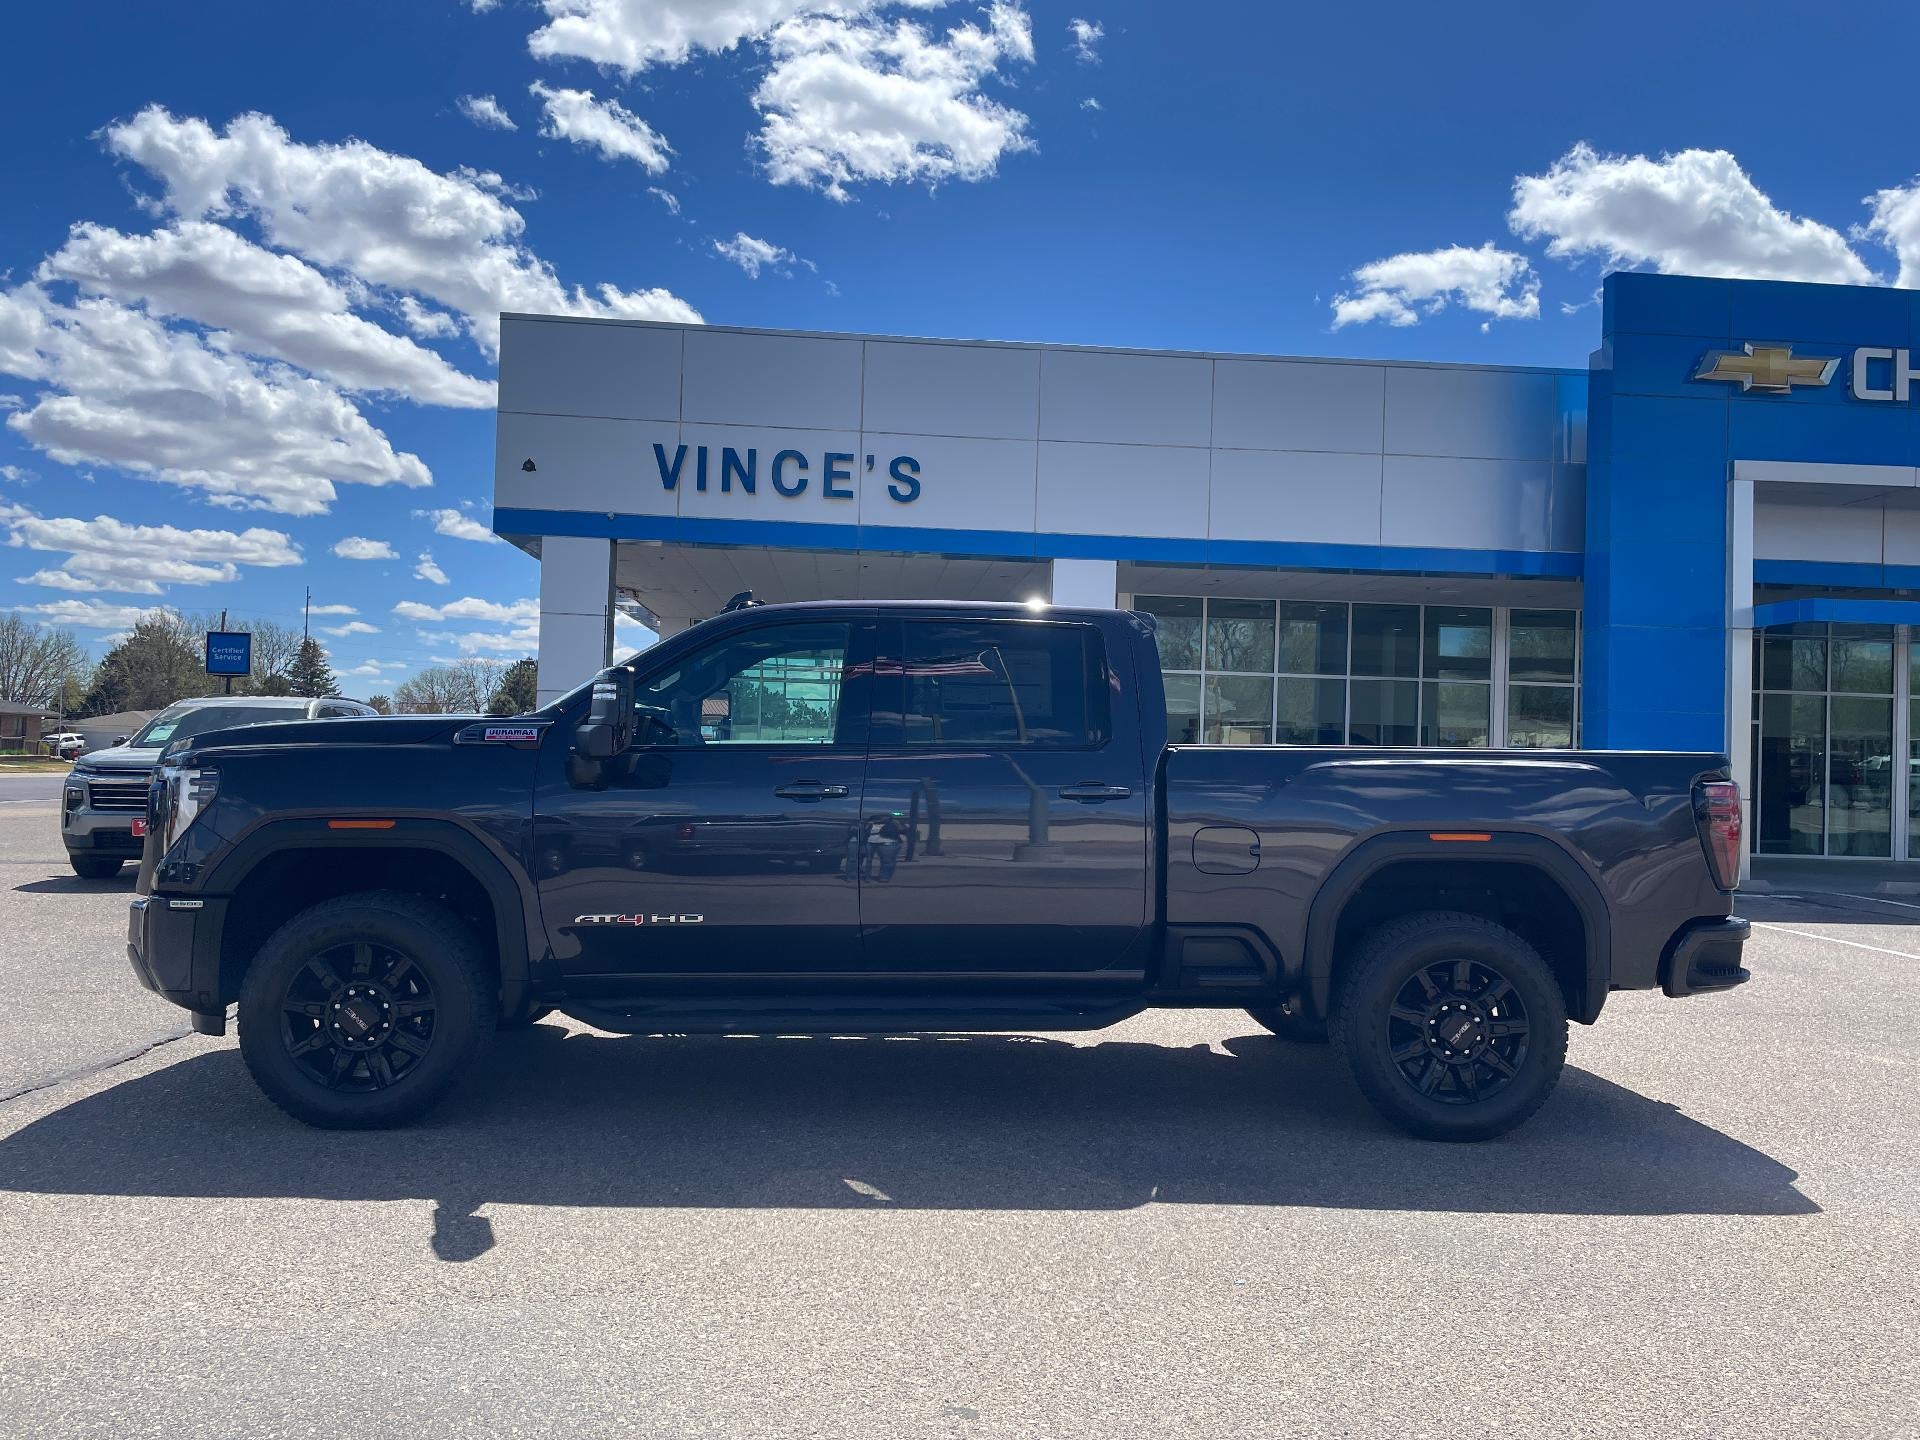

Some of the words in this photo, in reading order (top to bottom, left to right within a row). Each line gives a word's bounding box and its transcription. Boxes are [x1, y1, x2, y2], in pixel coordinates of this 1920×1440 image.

[652, 443, 921, 503] VINCE'S
[574, 913, 644, 926] AT4
[651, 913, 704, 923] HD
